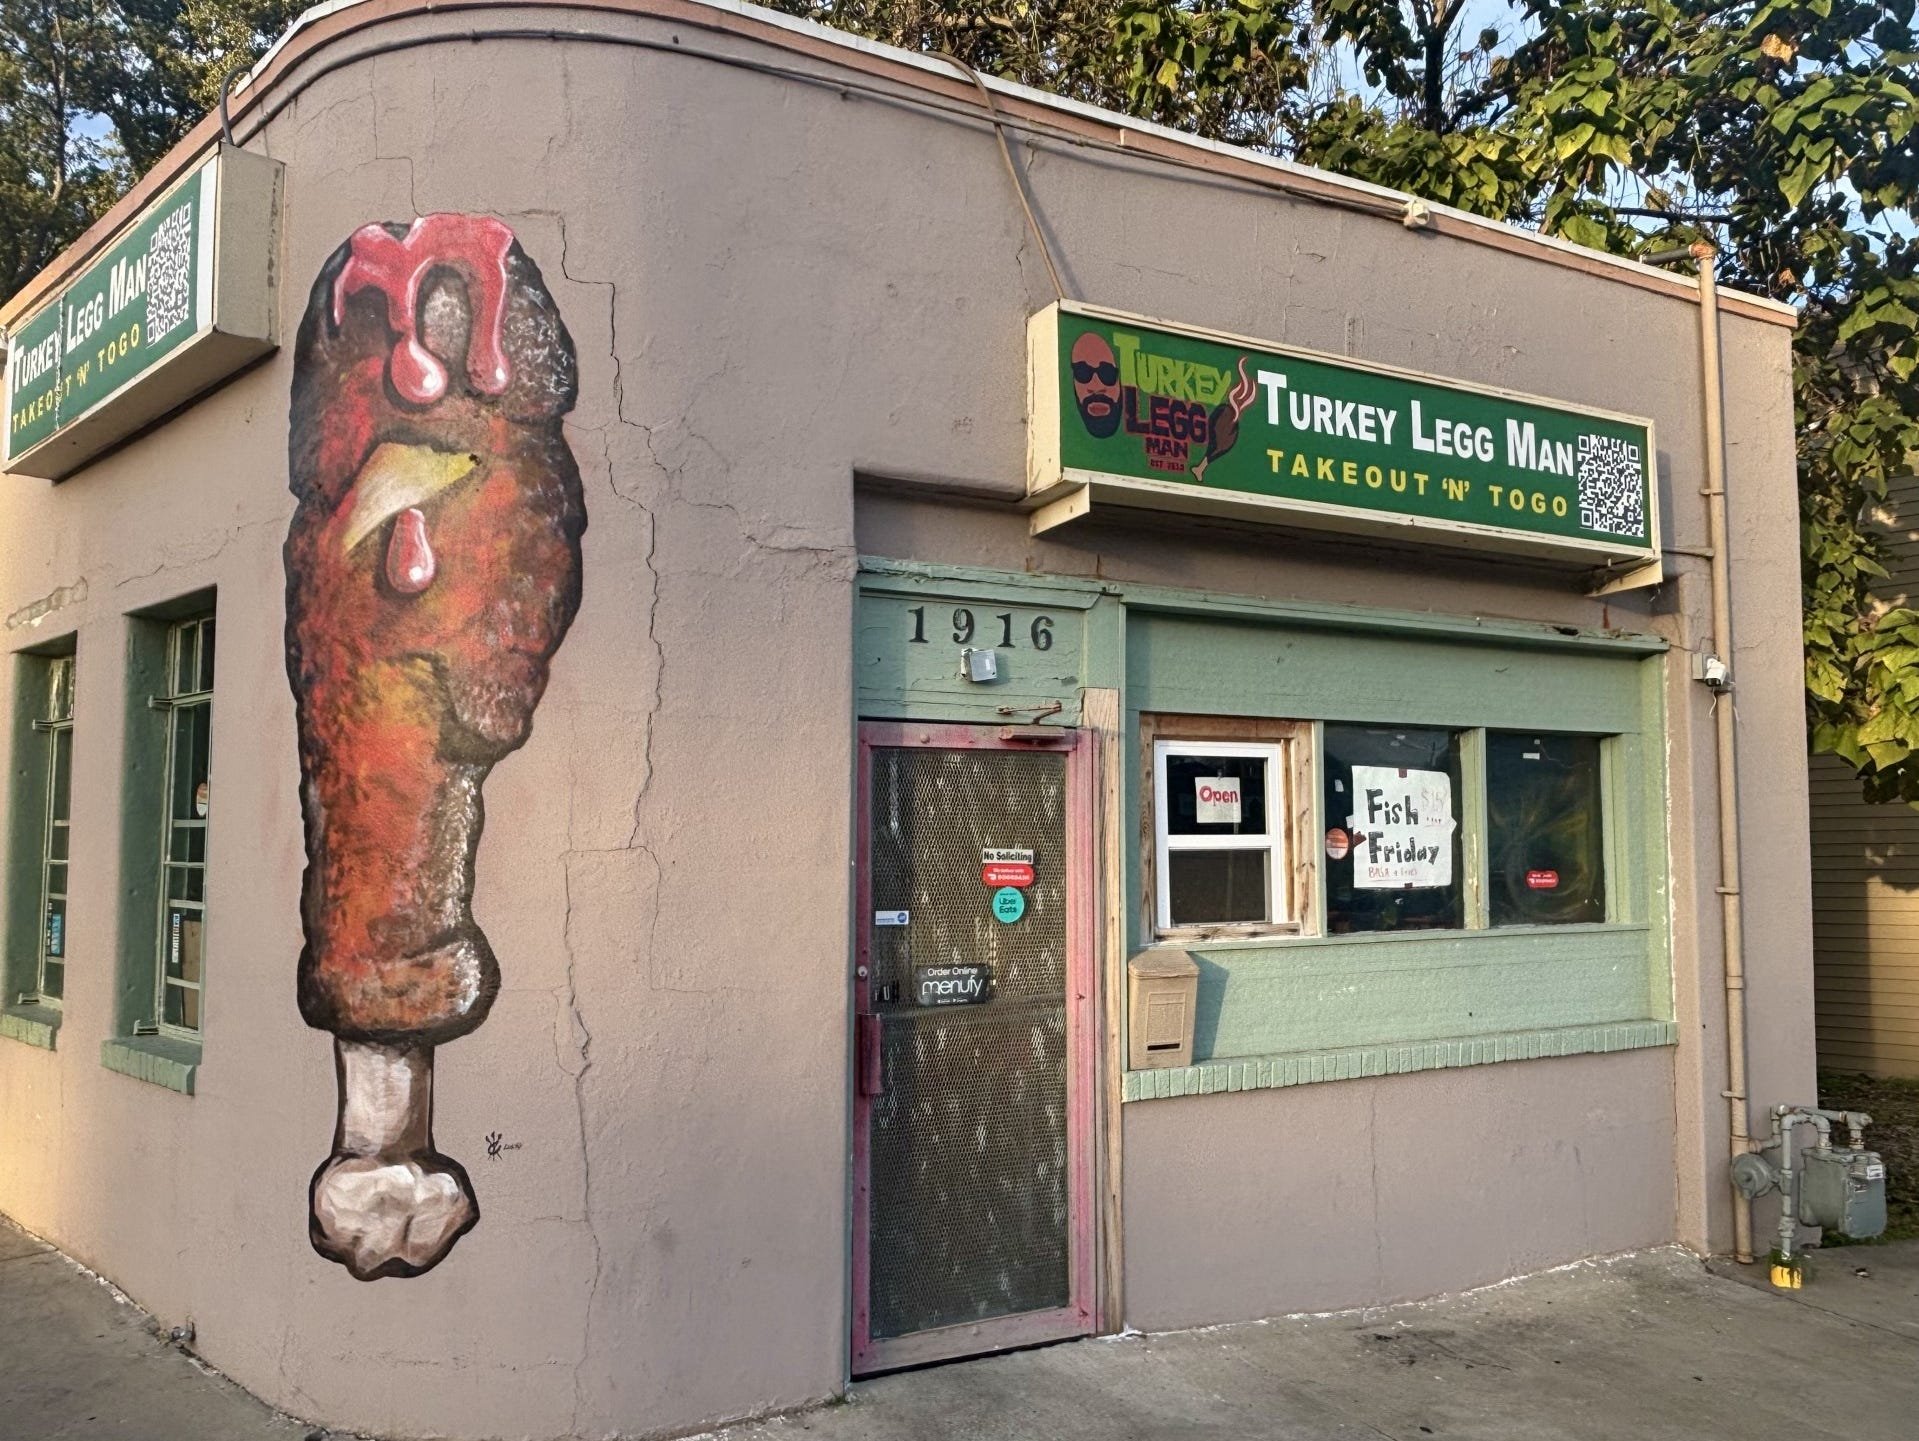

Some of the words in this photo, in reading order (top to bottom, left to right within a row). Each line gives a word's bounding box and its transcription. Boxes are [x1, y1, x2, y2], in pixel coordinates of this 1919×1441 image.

[13, 330, 62, 394] TURKEY
[66, 292, 104, 354] LEGG
[109, 254, 148, 320] MAN
[13, 375, 72, 434] TAKEOT
[98, 323, 140, 372] TOGO
[1113, 331, 1232, 406] TURKEY
[1122, 386, 1209, 444] LEGG
[1257, 369, 1397, 445] TURKEY
[1410, 400, 1494, 463] LEGG
[1505, 418, 1574, 477] MAN
[1145, 436, 1188, 459] MAN
[1266, 449, 1429, 495] TAKEOUT
[1488, 485, 1568, 517] TOGO
[907, 606, 1055, 651] 1916
[1199, 785, 1239, 806] Open
[1366, 788, 1419, 825] Fish
[983, 851, 994, 860] No
[1368, 831, 1440, 865] Friday
[922, 975, 983, 997] menufy
[927, 967, 951, 976] Order
[952, 967, 978, 975] Online
